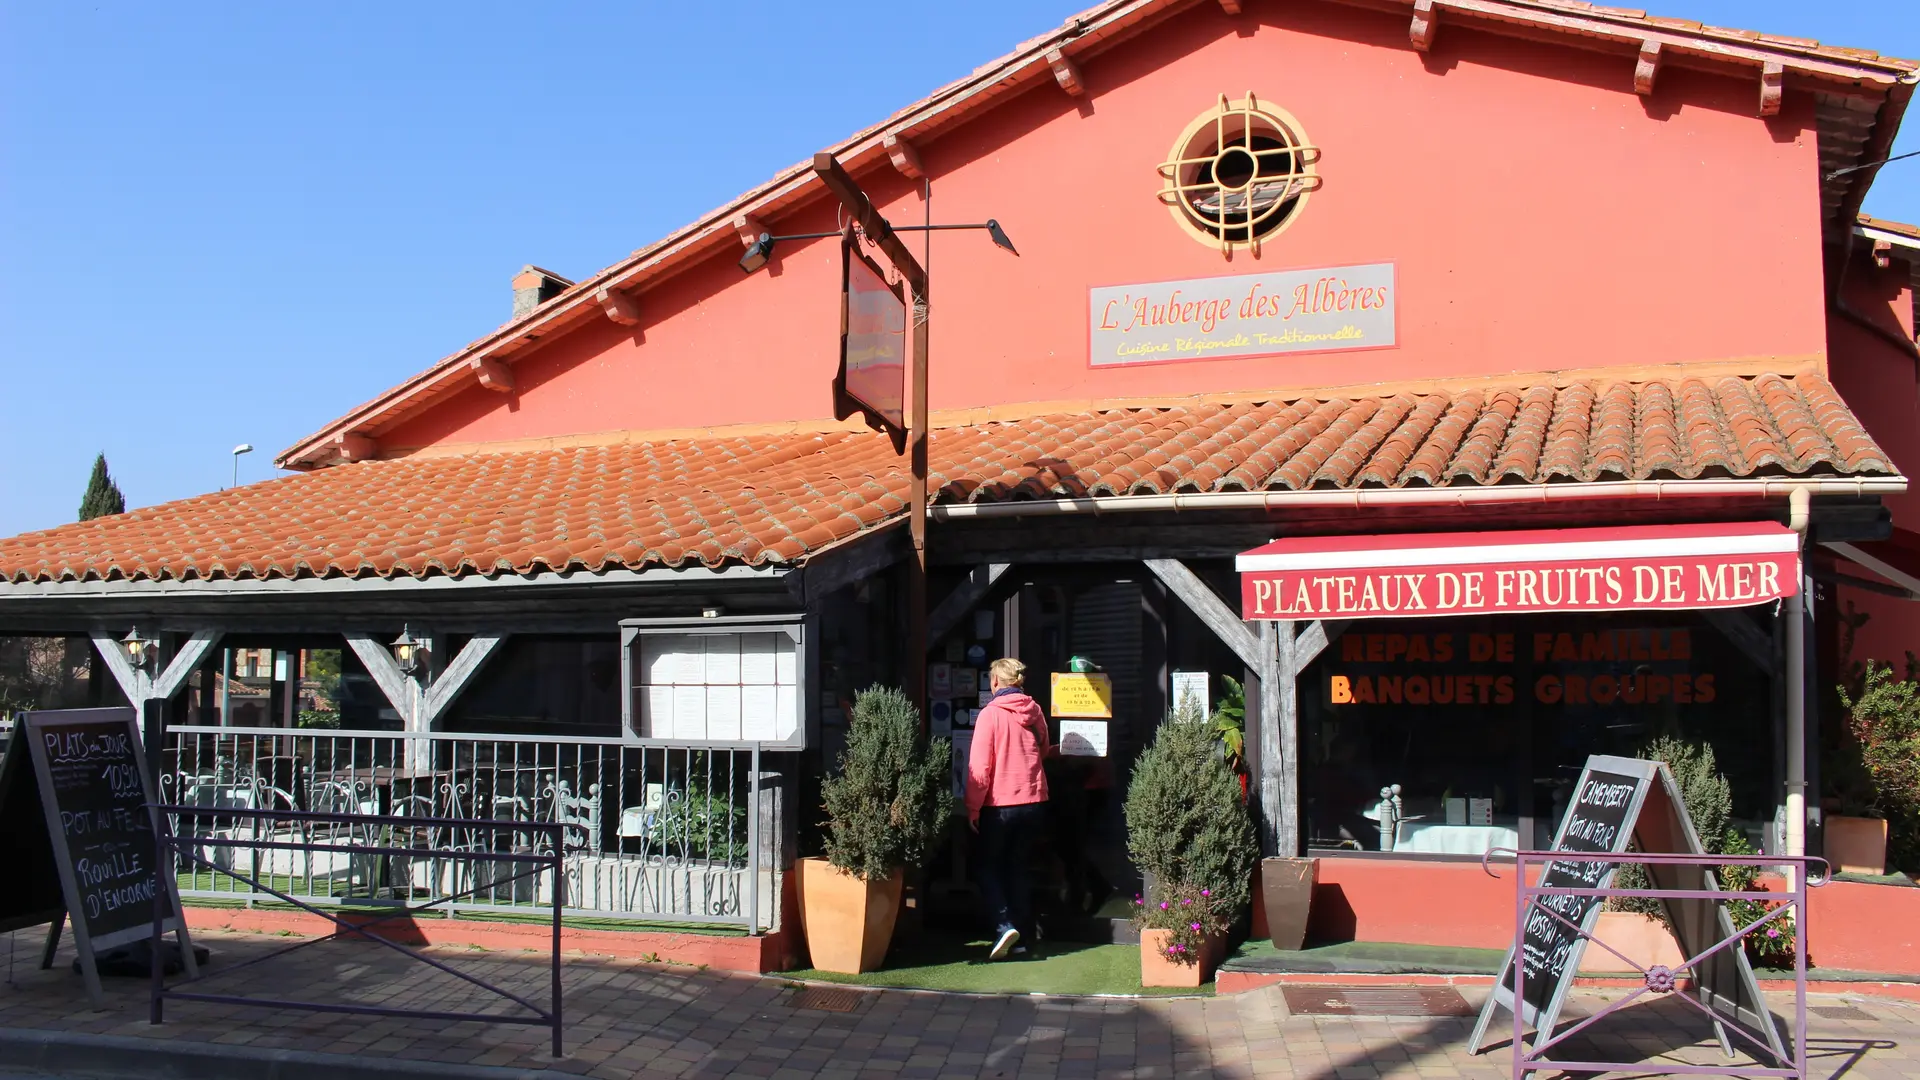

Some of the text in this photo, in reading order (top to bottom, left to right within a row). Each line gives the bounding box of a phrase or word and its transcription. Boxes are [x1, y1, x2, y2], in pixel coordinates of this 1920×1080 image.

[1097, 276, 1388, 334] L'Auberge des Albères
[1116, 324, 1365, 357] Cuisine Régionale Traditionnelle
[1252, 560, 1782, 615] PLATEAUX DE FRUITS DE MER
[1341, 629, 1693, 662] REPAS DE FAMILLE
[1330, 672, 1717, 704] BANQUETS GROUPES
[45, 732, 89, 757] PLATS
[99, 733, 132, 755] JOUR
[1580, 779, 1634, 808] CAMEMBERT
[60, 810, 91, 836] POT
[97, 808, 111, 830] AU
[1582, 818, 1595, 842] AU
[1591, 821, 1615, 851] FOUR
[86, 872, 157, 919] D'ENCORNE
